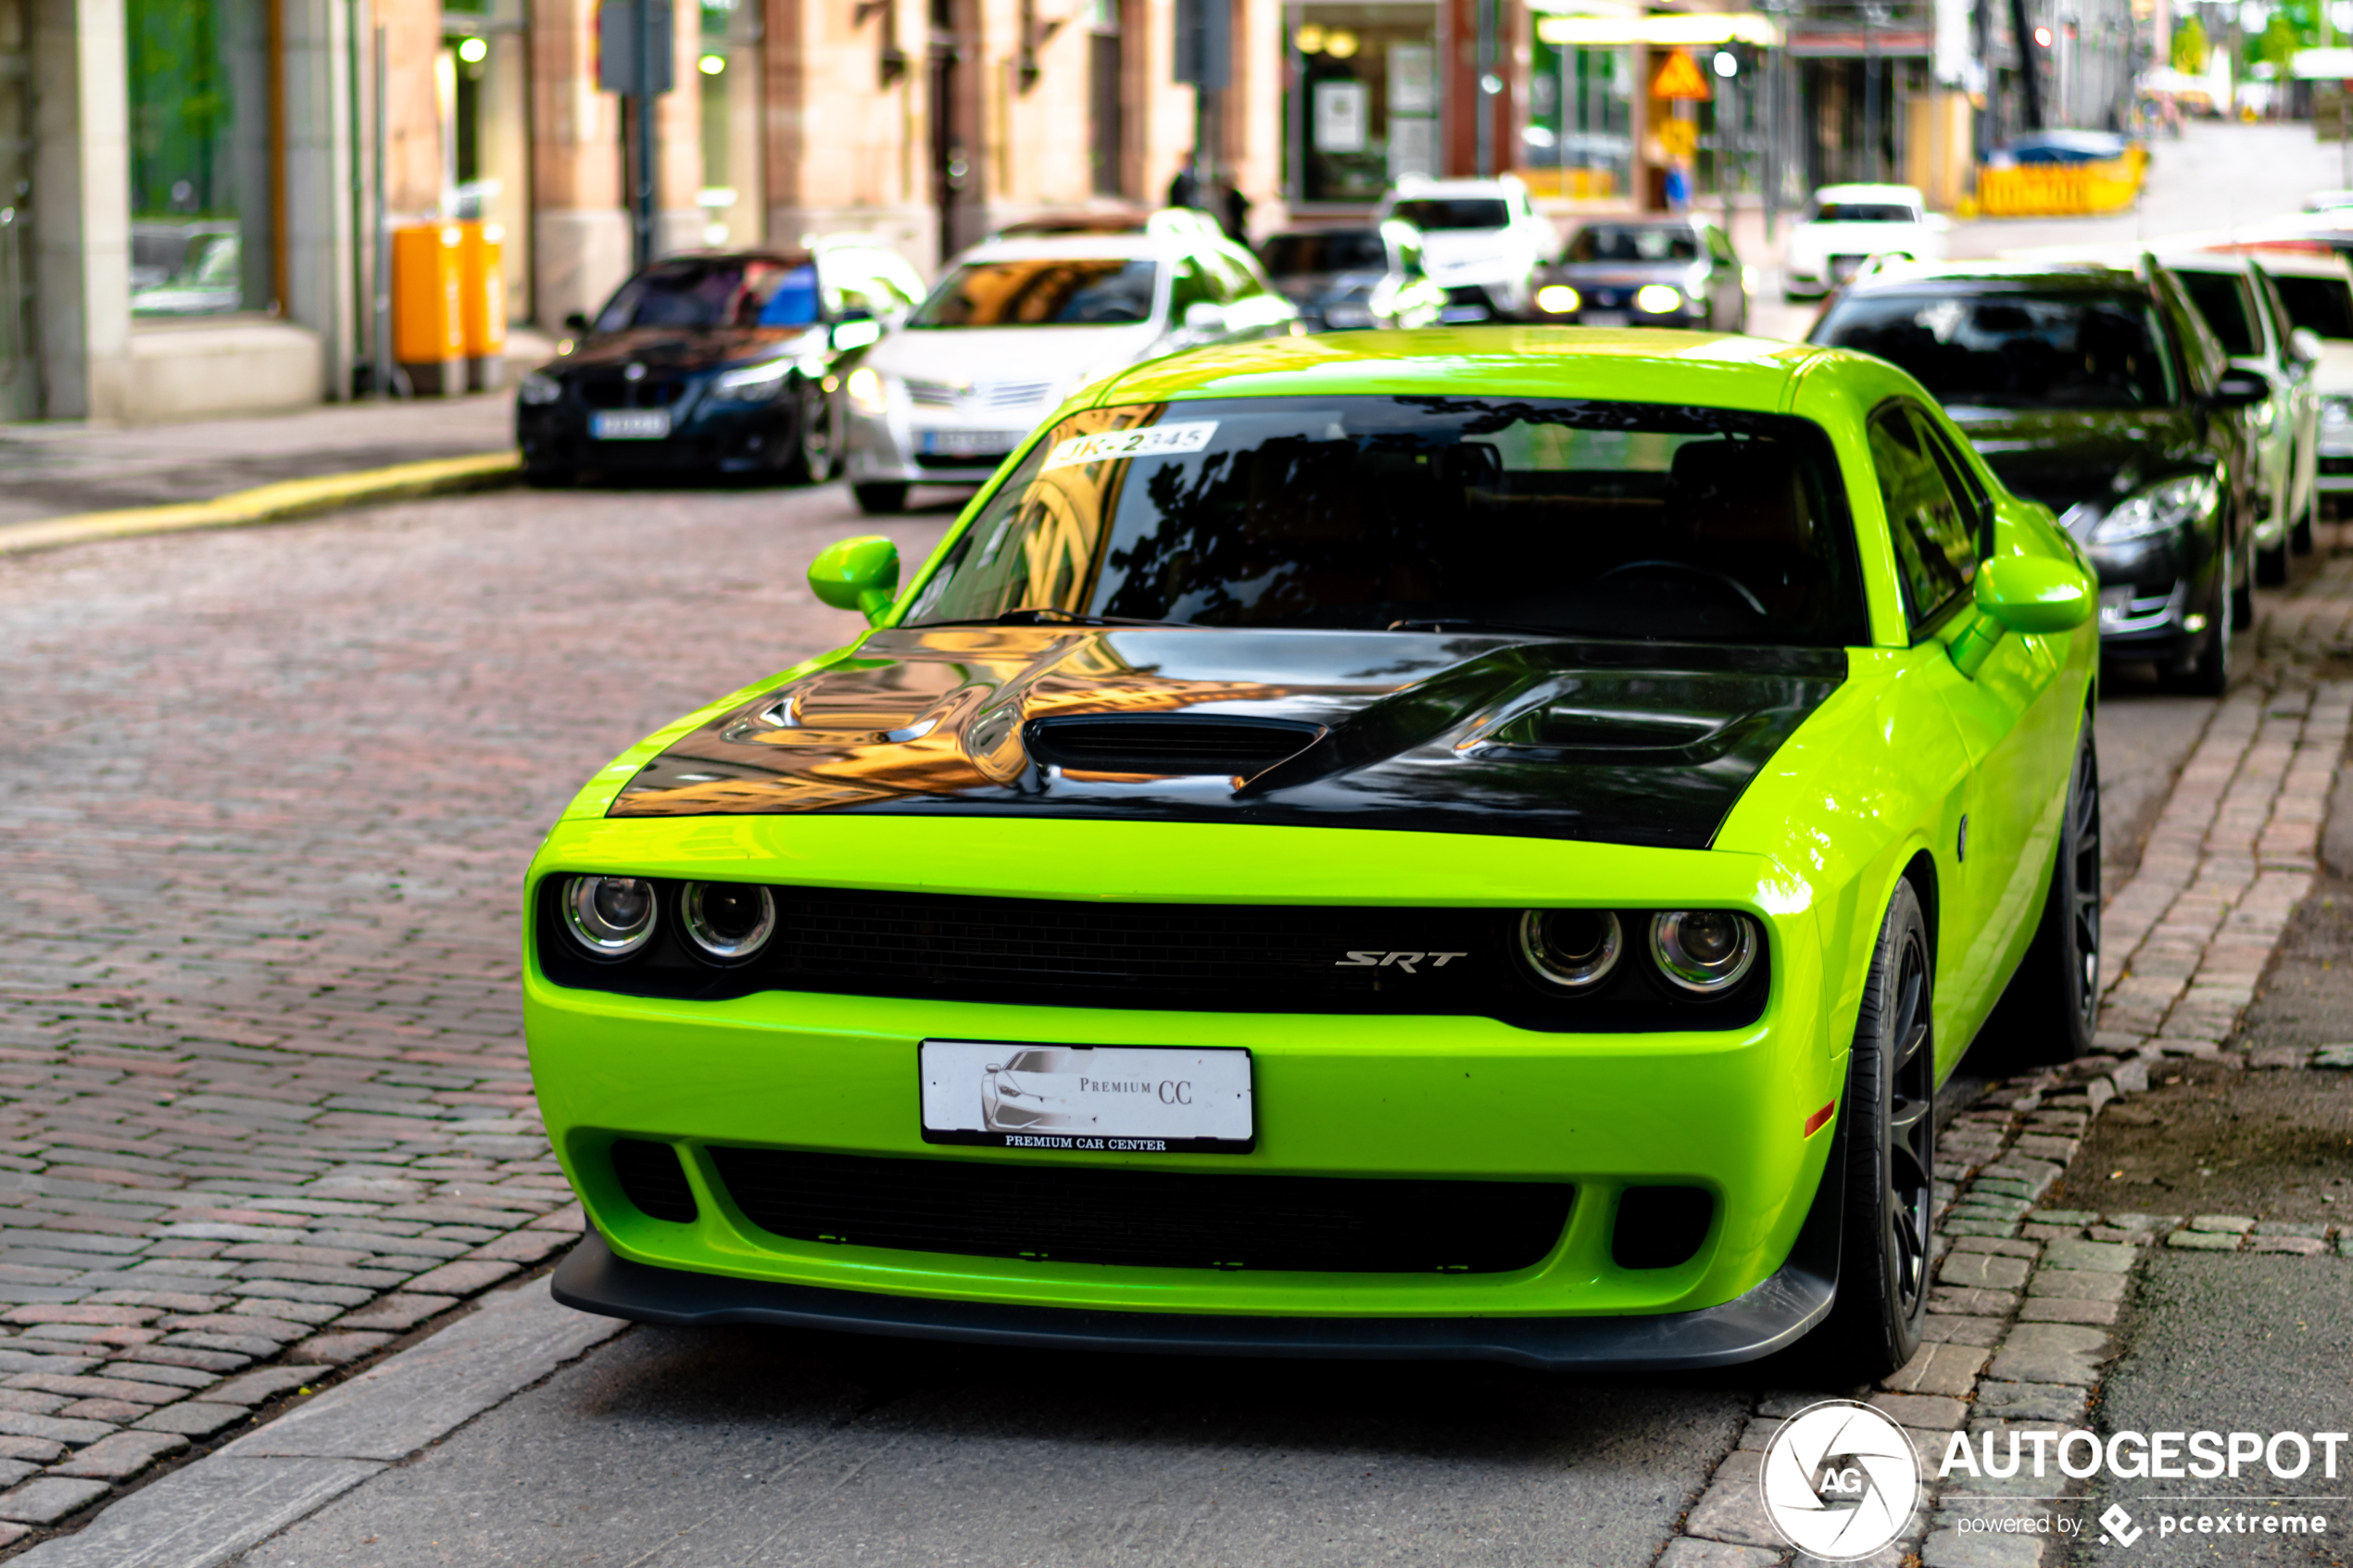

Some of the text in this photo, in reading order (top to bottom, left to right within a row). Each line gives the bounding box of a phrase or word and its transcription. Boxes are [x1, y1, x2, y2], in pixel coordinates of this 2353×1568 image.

[1335, 950, 1468, 973] SRT
[1079, 1077, 1192, 1105] PREMIUM CC
[1005, 1135, 1166, 1151] PREMIUM CAR CENTER
